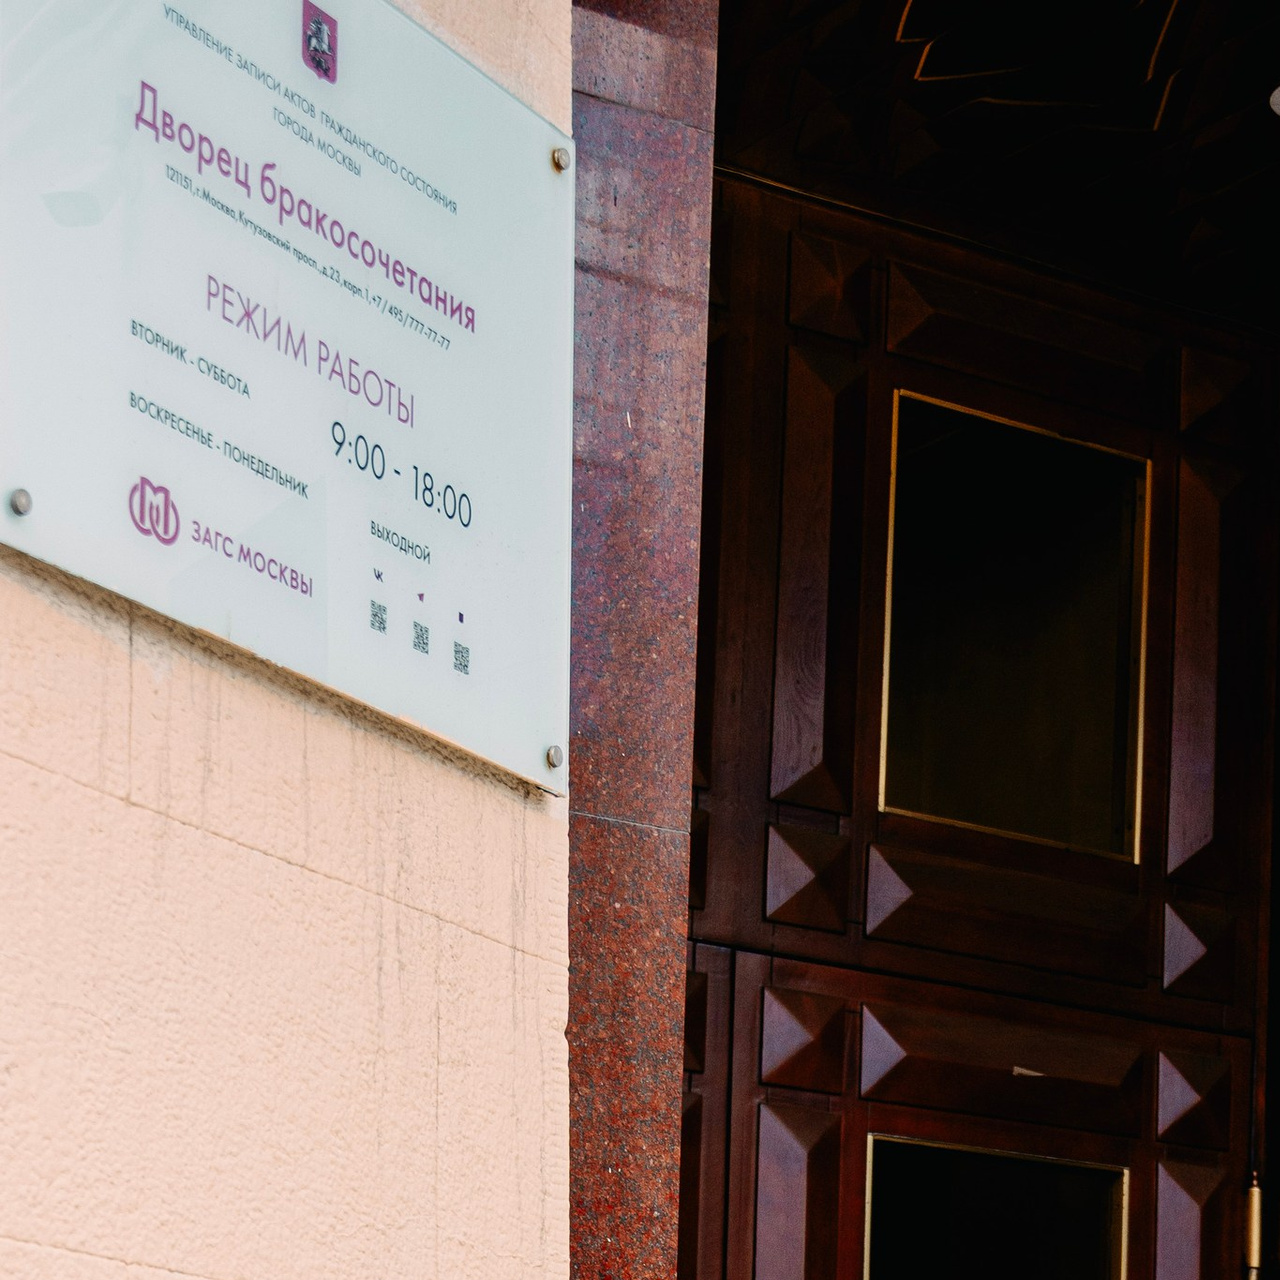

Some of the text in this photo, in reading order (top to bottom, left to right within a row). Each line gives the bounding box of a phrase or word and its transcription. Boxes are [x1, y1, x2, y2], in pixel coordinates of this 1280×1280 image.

[163, 4, 458, 216] УПРАВЛЕНИЕ ЗАПИСИ АКТОВ ГРАЖДАНСКОГО СОСТОЯНИЯ
[273, 107, 362, 178] ГОРОДА МОСКВЫ
[135, 80, 476, 334] Дворец бракосочетания
[131, 319, 187, 364] ВТОРНИК
[198, 357, 251, 400] СУББОТА
[206, 273, 415, 429] РЕЖИМ РАБОТЫ
[130, 391, 214, 450] ВОСКРЕСЕНЬЕ
[223, 441, 309, 500] ПОНЕДЕЛЬНИК
[332, 421, 385, 480] 9:00
[412, 465, 472, 528] 18:00
[191, 520, 313, 598] ЗАГС МОСКВЫ
[370, 520, 431, 564] ВЫХОДНОЙ
